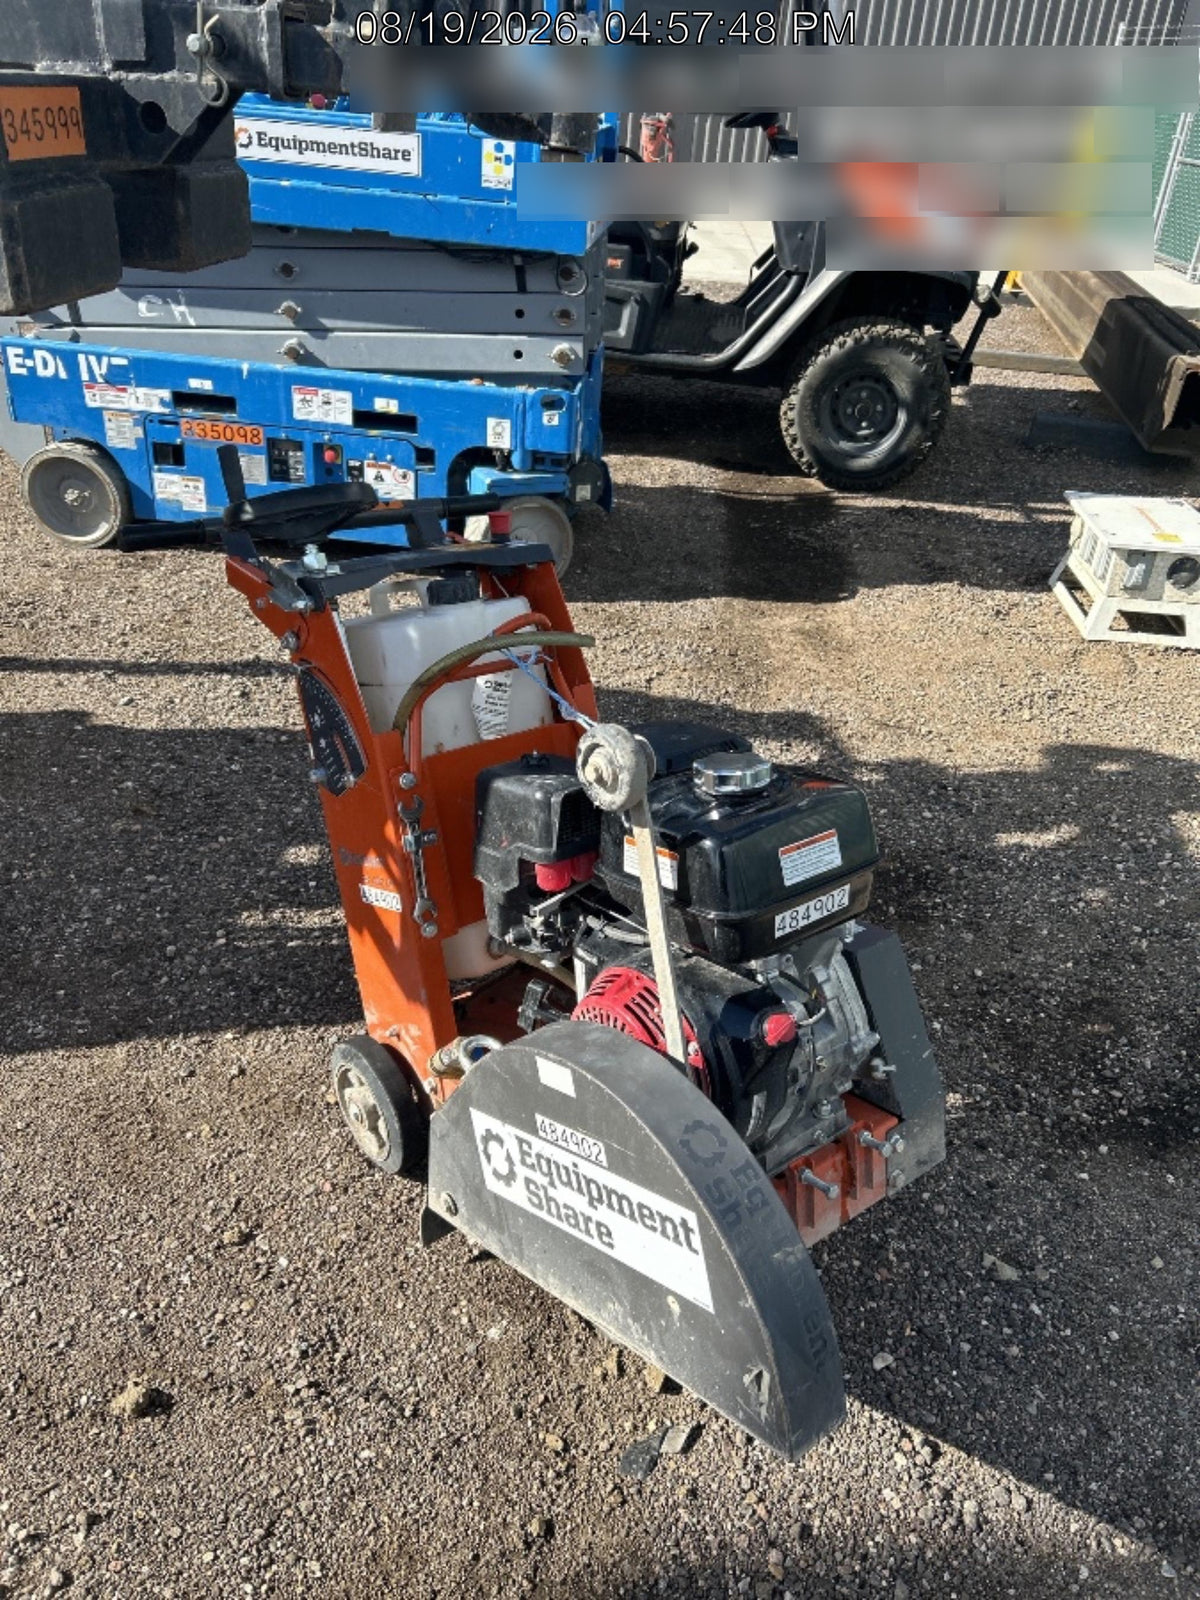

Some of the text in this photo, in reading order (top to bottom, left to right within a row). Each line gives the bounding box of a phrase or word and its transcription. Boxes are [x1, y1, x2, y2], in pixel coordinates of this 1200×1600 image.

[4, 106, 82, 144] 345999
[255, 131, 412, 162] EquipmentShare
[6, 346, 128, 382] E-DIV
[776, 888, 847, 931] 484902
[538, 1118, 604, 1164] 484902
[513, 1133, 700, 1255] Equipment
[523, 1178, 615, 1250] Share
